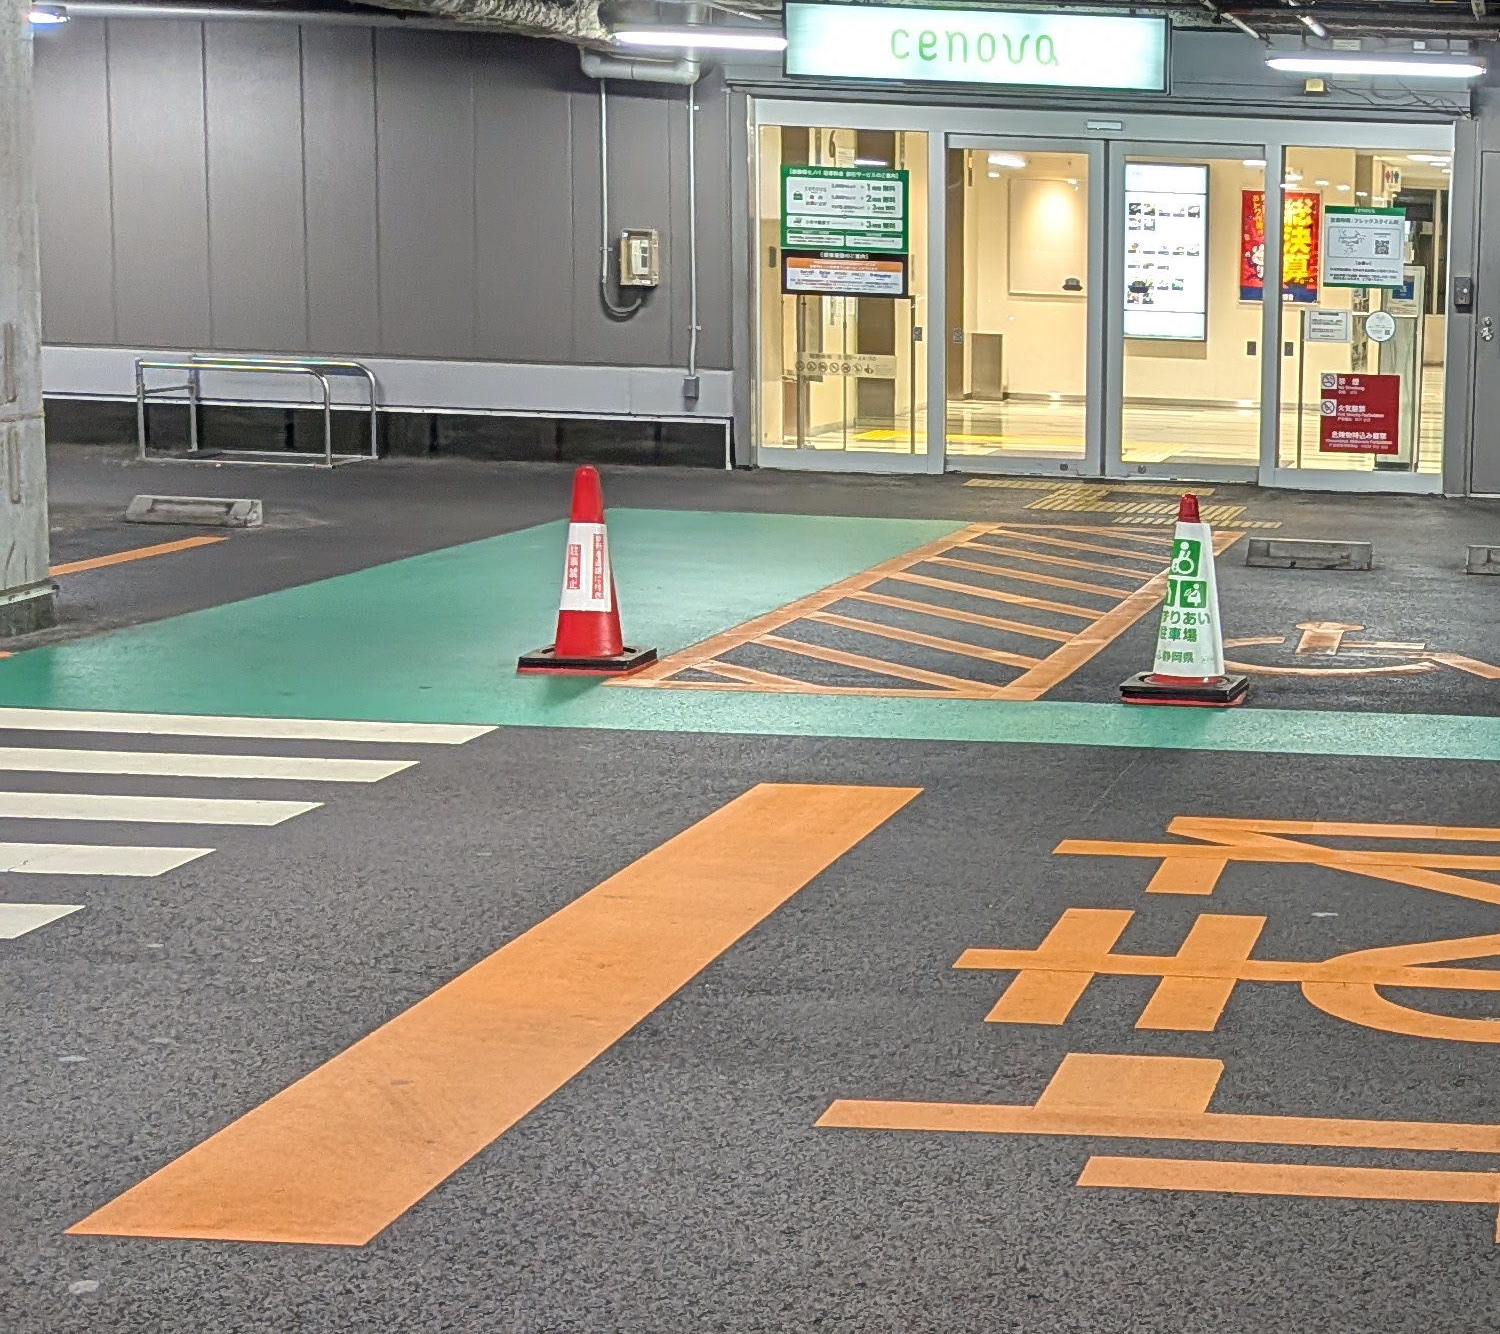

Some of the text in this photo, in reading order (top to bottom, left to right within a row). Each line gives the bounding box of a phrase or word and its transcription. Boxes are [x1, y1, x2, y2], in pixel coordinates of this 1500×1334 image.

[890, 28, 1059, 67] cenova
[1162, 650, 1194, 664] 静岡県
